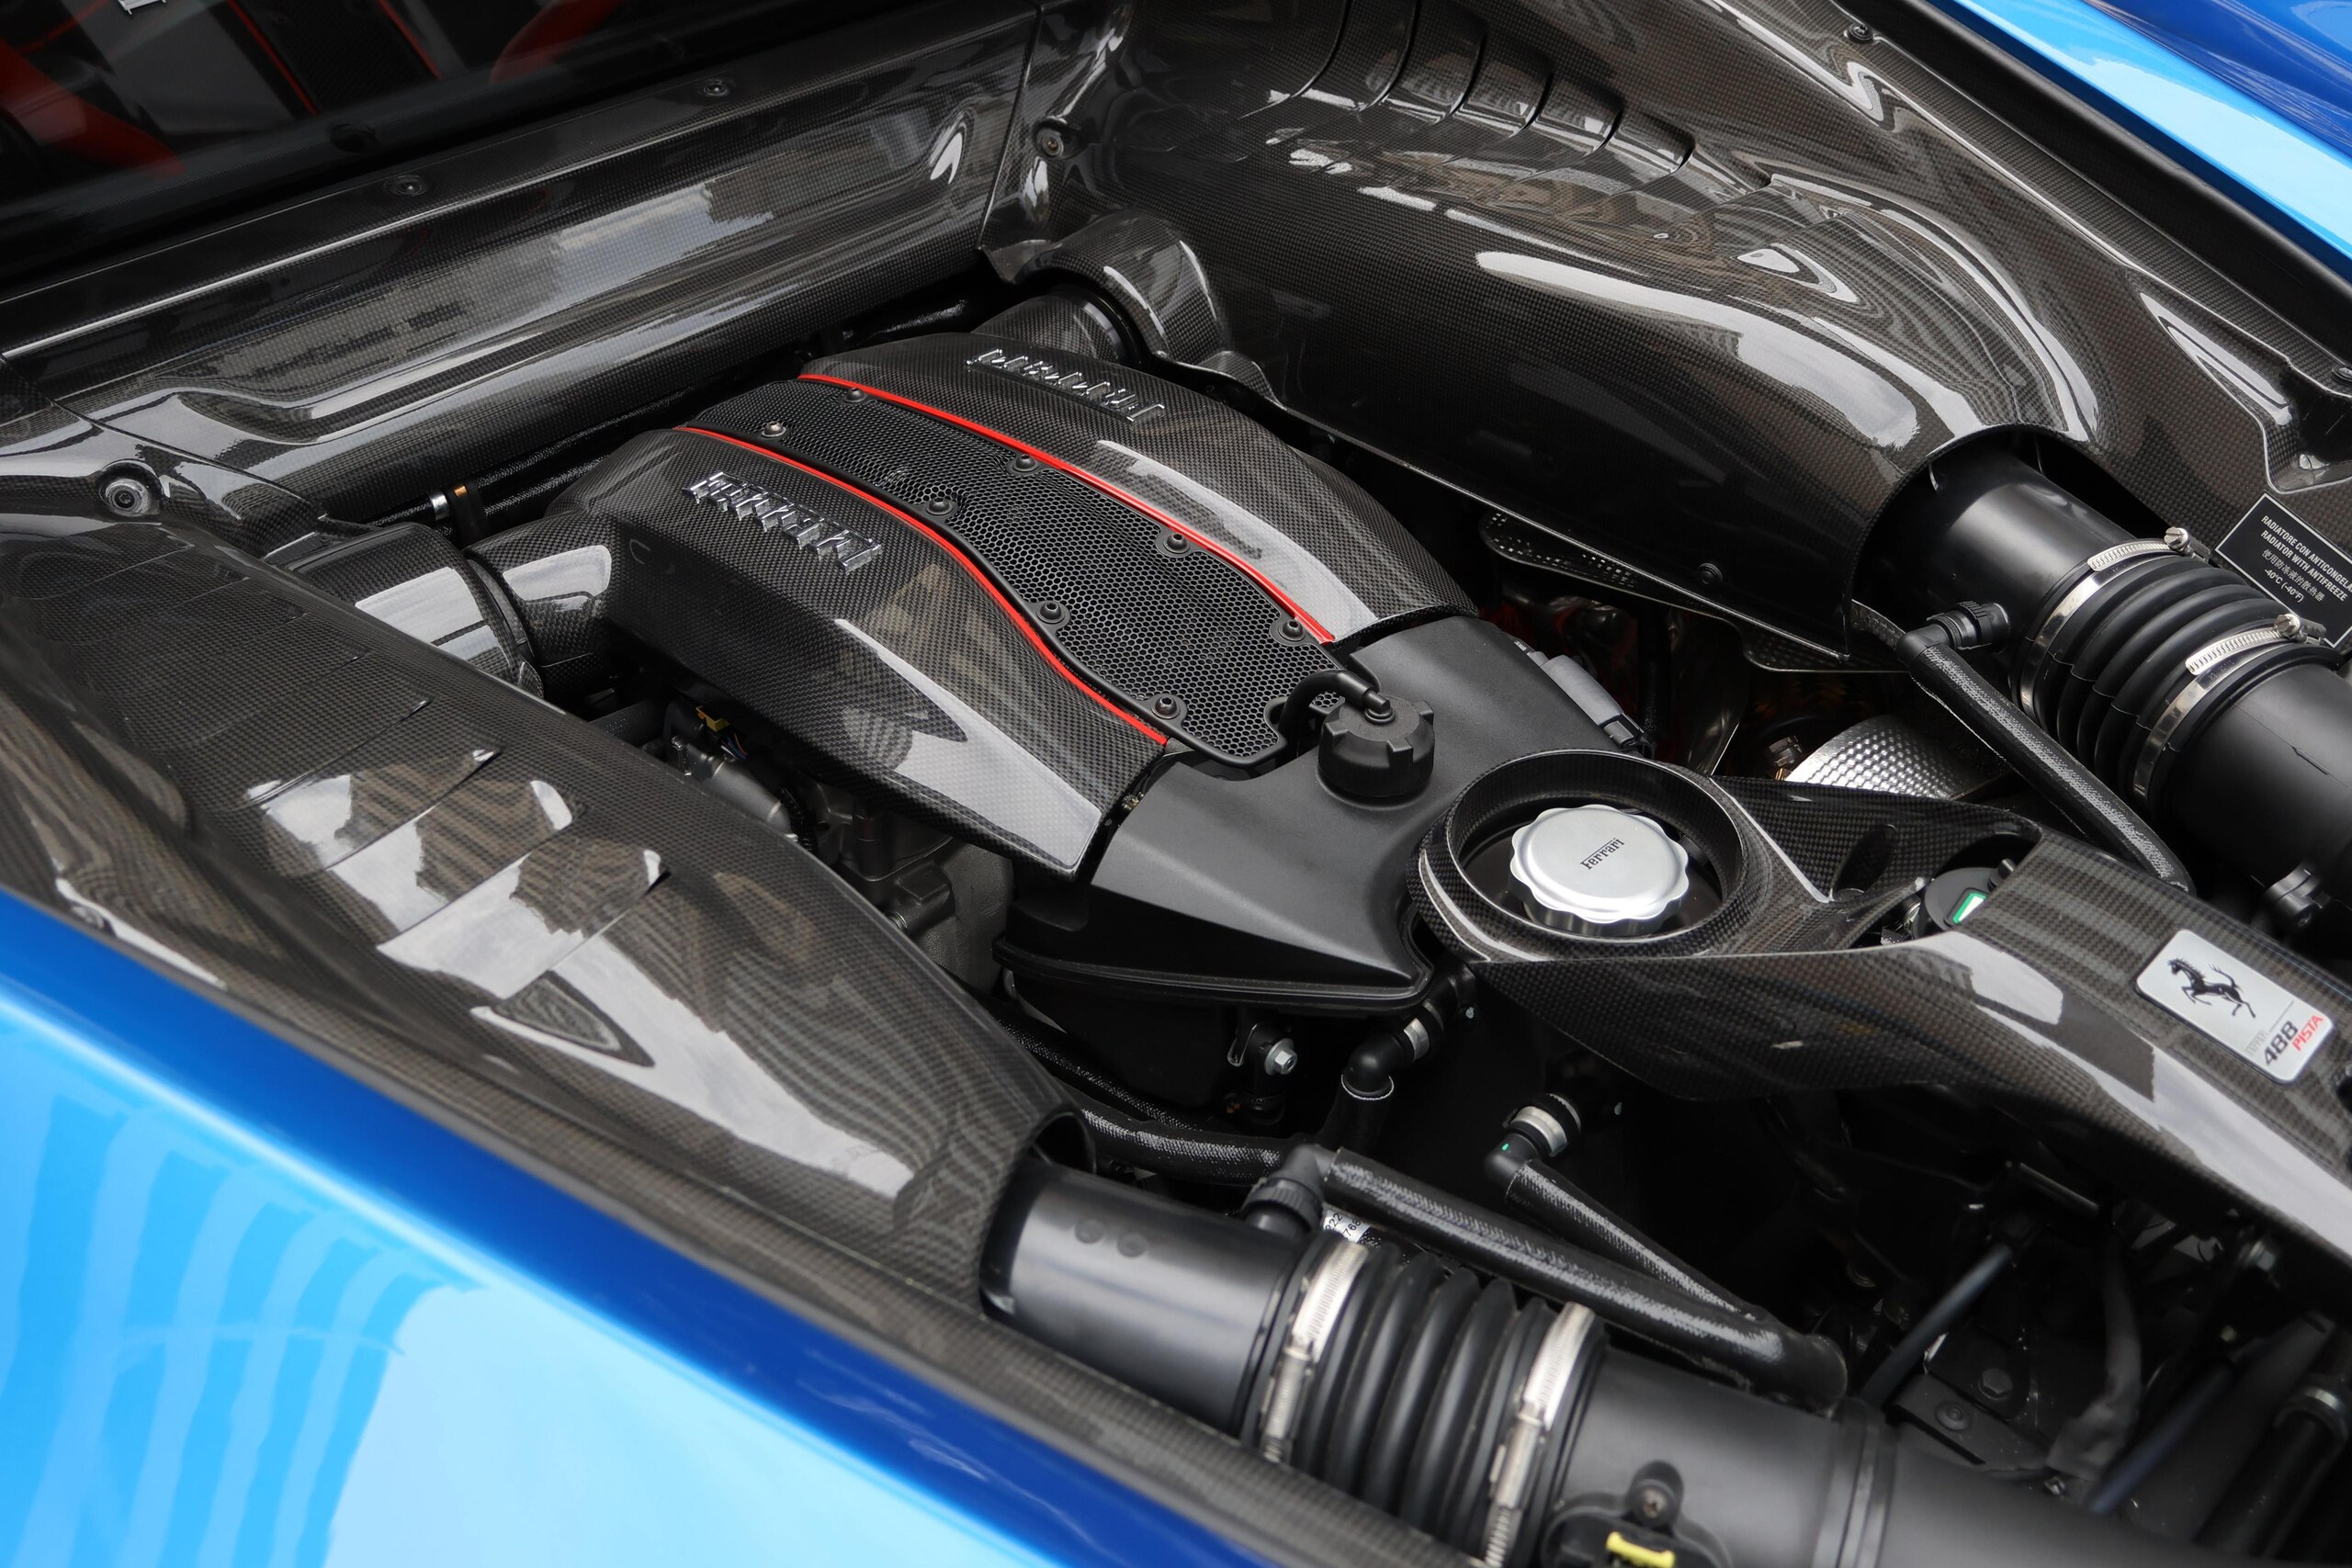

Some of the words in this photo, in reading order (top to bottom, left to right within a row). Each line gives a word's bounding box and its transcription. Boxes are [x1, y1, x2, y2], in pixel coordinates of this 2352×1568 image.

[682, 471, 882, 574] Ferrari
[2261, 515, 2297, 547] RADIATORE
[2296, 543, 2311, 557] CON
[2308, 553, 2352, 594] ANTICONGELA
[2261, 531, 2293, 558] RADIATOR
[2291, 554, 2312, 572] WITH
[2307, 568, 2348, 602] ANTIFREEZE
[2261, 548, 2325, 602] 使用防冻液的散热器
[1581, 837, 1625, 870] Ferrari
[2265, 1021, 2299, 1066] 488
[2292, 1016, 2324, 1051] PISTA
